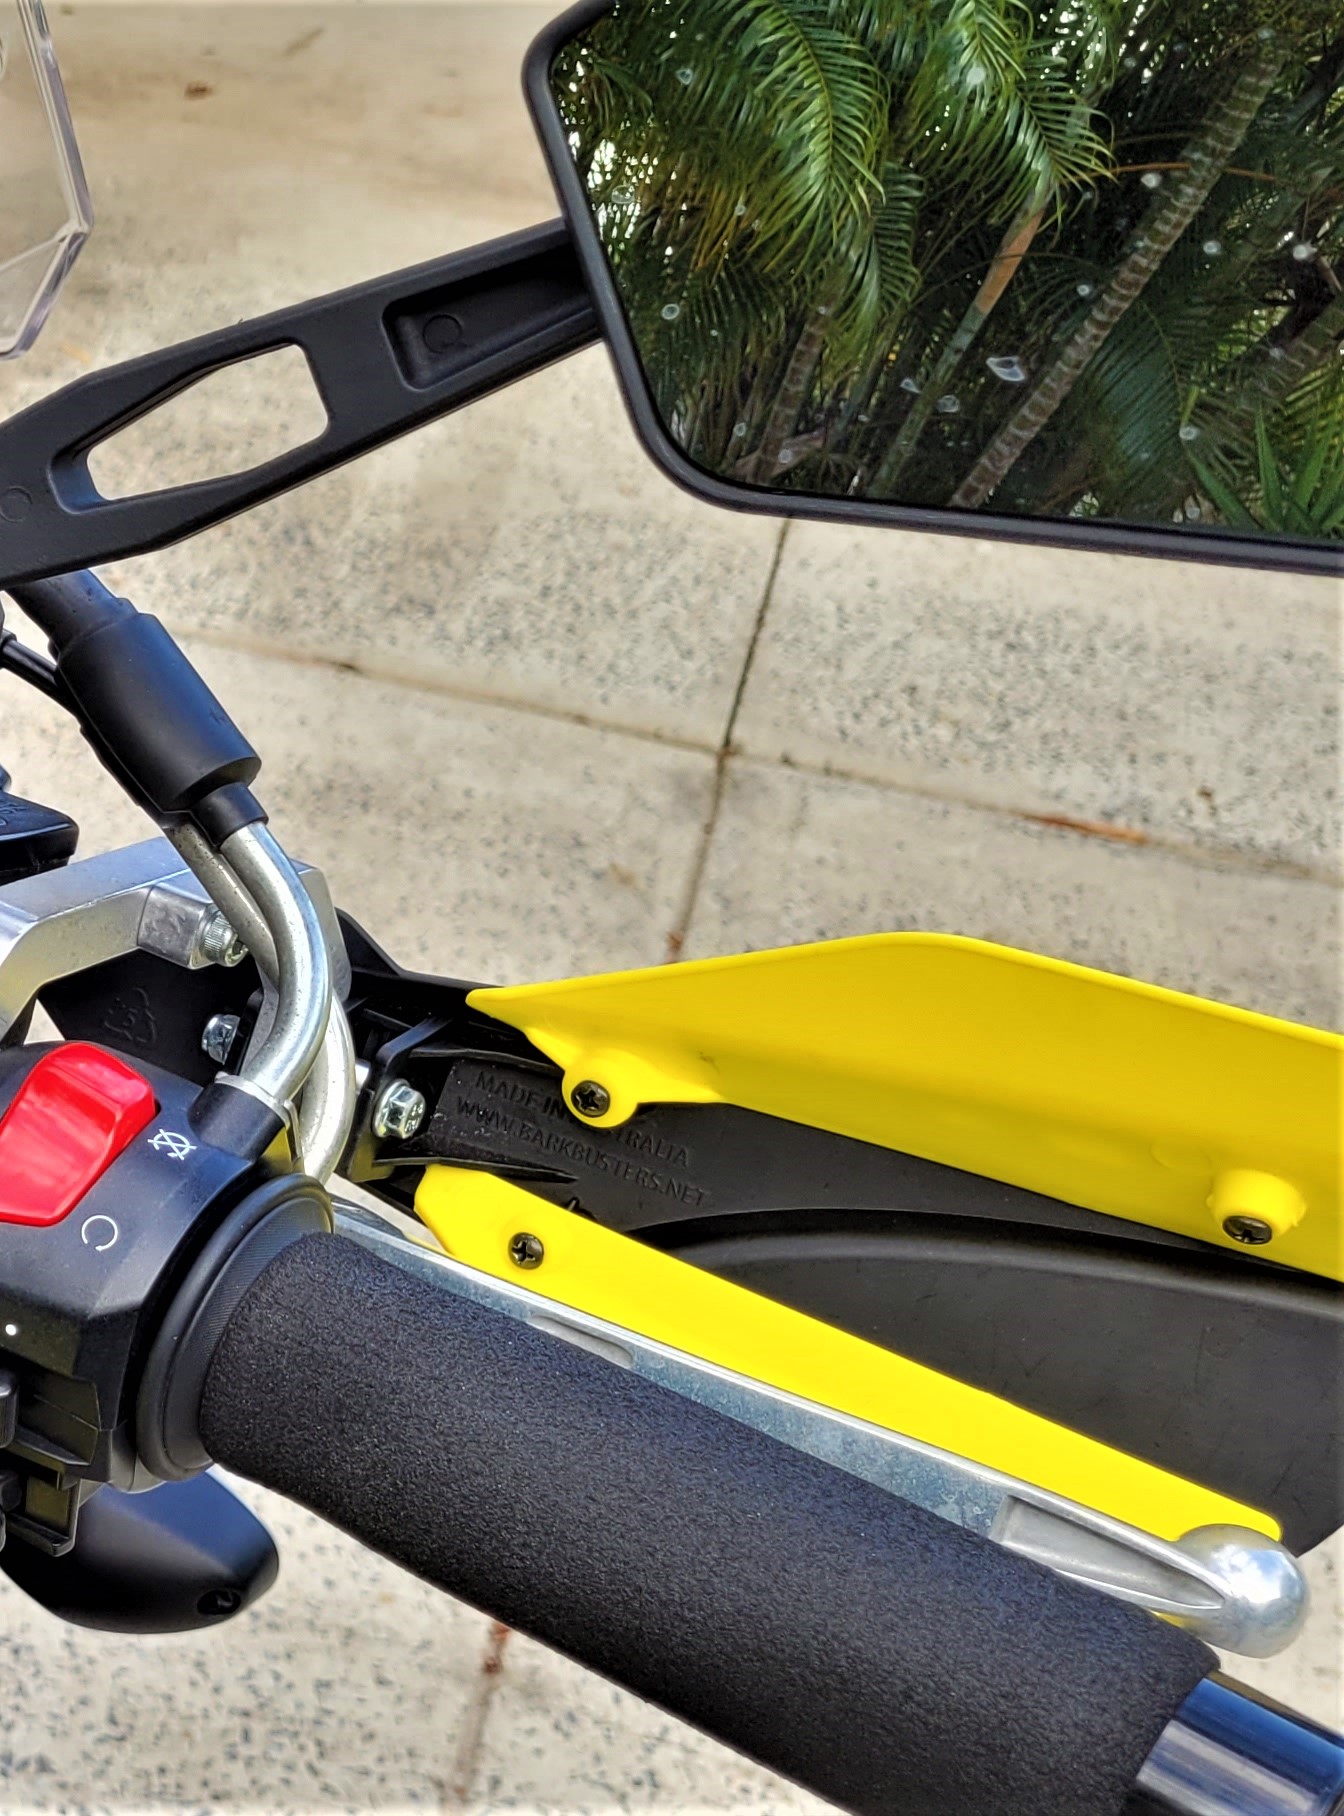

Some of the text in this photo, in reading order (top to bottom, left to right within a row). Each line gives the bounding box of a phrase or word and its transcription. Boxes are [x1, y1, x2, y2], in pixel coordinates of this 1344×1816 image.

[475, 1070, 537, 1108] MADE
[542, 1095, 565, 1121] IN
[456, 1096, 708, 1208] WWW.BARKBUSTERS.NET
